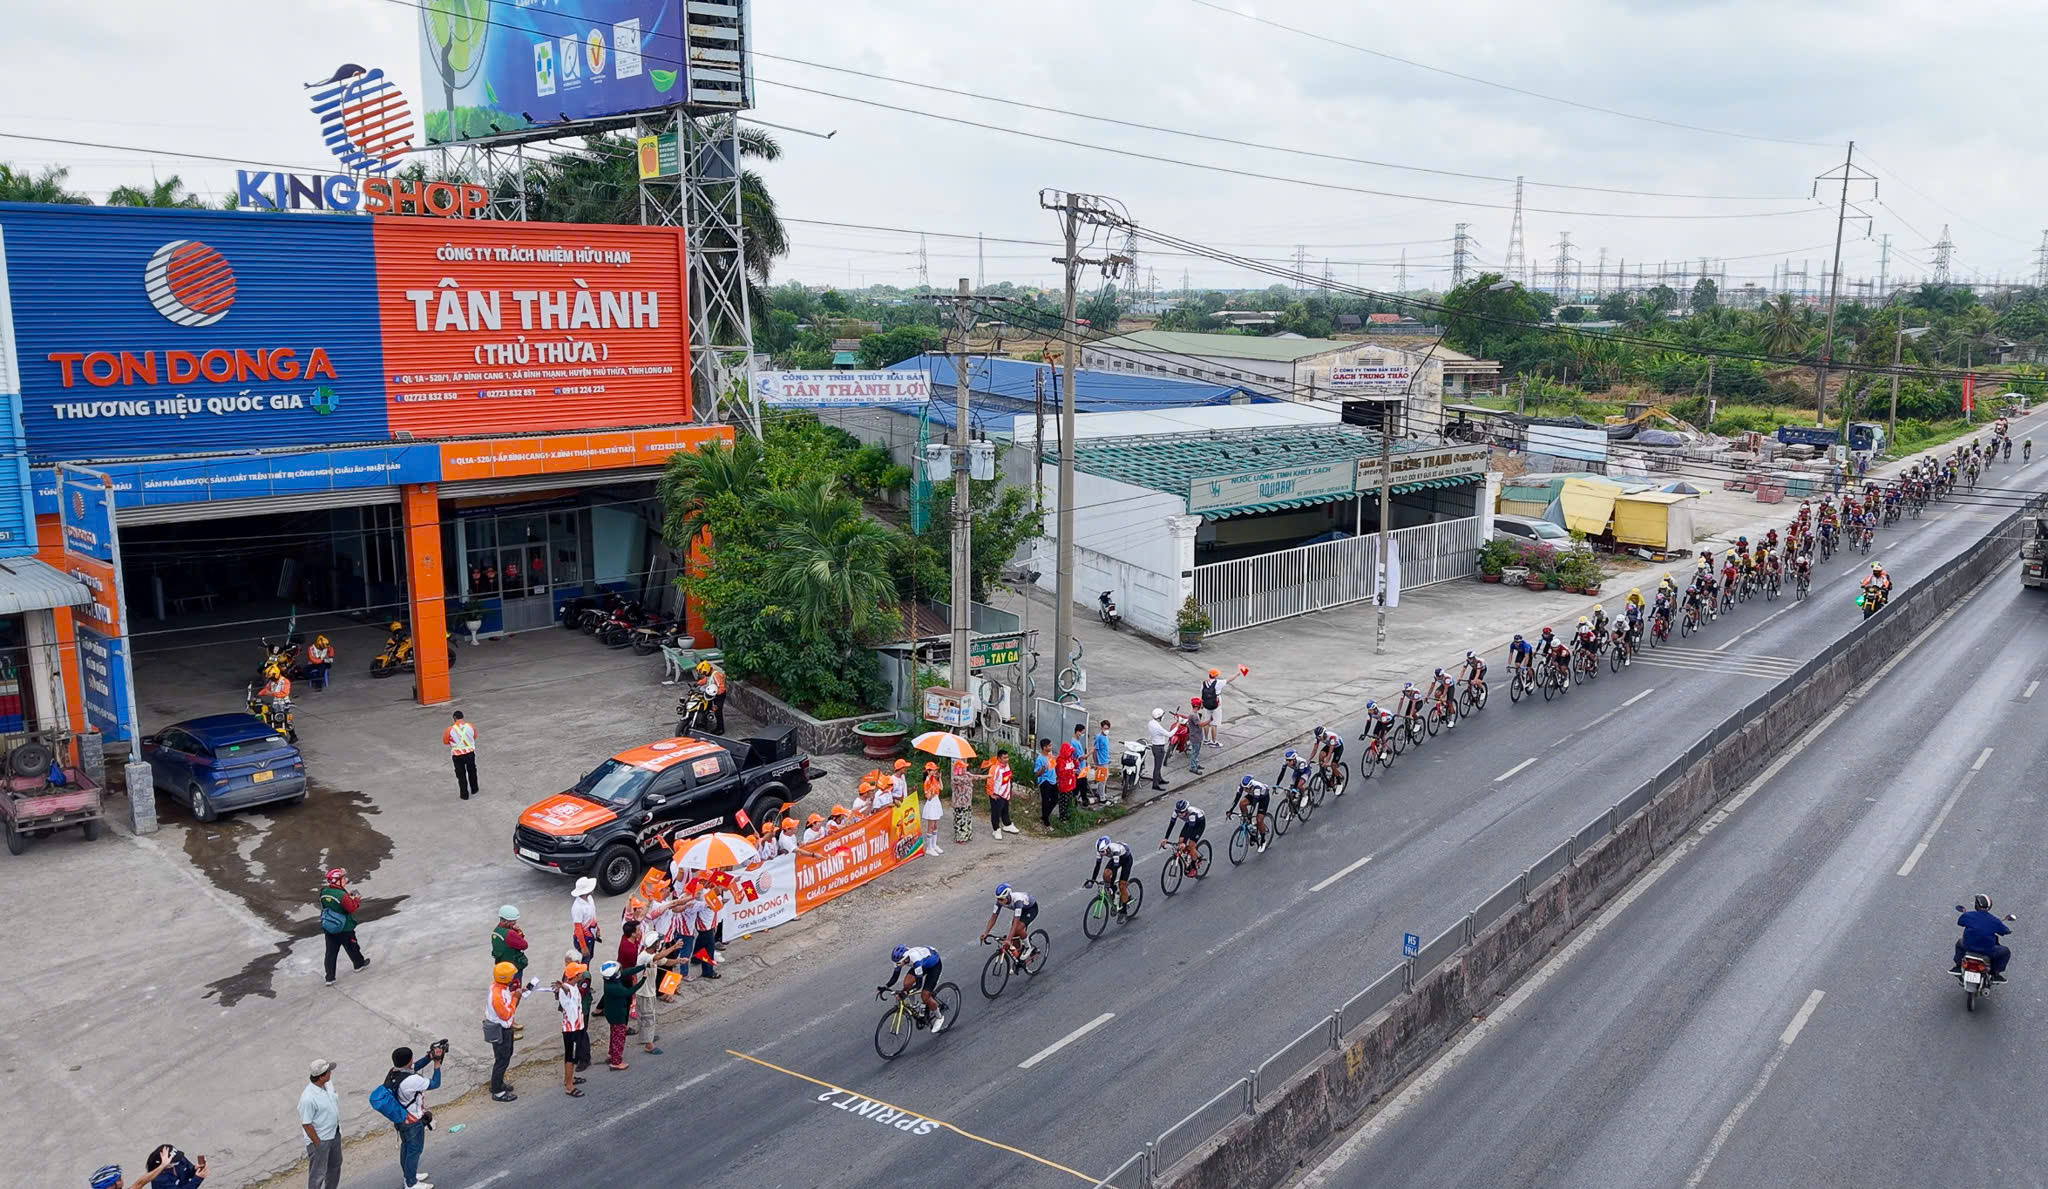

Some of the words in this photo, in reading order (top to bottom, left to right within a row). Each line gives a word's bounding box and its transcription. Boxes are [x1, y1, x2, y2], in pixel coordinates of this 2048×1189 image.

[436, 242, 474, 262] CÔNG
[476, 247, 492, 262] TY
[493, 244, 535, 262] TRÁCH
[537, 246, 574, 267] NHIỆM
[575, 246, 603, 264] HỮU
[604, 249, 631, 268] HẠN
[406, 276, 501, 332] TÂN
[513, 278, 660, 331] THÀNH
[48, 352, 157, 388] TON
[166, 348, 299, 385] DONG
[303, 347, 338, 381] A
[402, 375, 413, 384] QL
[464, 372, 482, 382] BÌNH
[484, 372, 504, 381] CANG
[512, 370, 522, 379] XÃ
[524, 370, 541, 379] BÌNH
[569, 367, 592, 378] HUYỆN
[593, 366, 606, 376] THỦ
[645, 366, 661, 375] LONG
[663, 366, 673, 374] AN
[782, 373, 809, 381] CÔNG
[403, 393, 427, 402] 02723
[428, 393, 442, 401] 832
[486, 390, 508, 398] 02723
[783, 381, 820, 396] TÂN
[825, 381, 890, 397] THÀNH
[895, 382, 926, 399] LỢI
[53, 400, 151, 420] THƯƠNG
[155, 393, 202, 419] HIỆU
[207, 389, 264, 416] QUỐC
[269, 394, 304, 411] GIA
[1423, 453, 1453, 468] THẠNH
[144, 479, 163, 489] SẢN
[227, 472, 247, 483] XUẤT
[295, 468, 315, 478] CÔNG
[1276, 471, 1293, 480] TINH
[991, 652, 1006, 664] TAY
[1007, 650, 1019, 662] GA
[796, 863, 815, 890] TÂN
[815, 853, 845, 882] THÀNH
[851, 836, 868, 865] THỦ
[869, 830, 890, 857] THỪA
[806, 884, 827, 900] CHÀO
[732, 906, 755, 921] TON
[757, 894, 782, 915] DONG
[783, 892, 790, 902] A
[817, 1087, 844, 1102] 2
[832, 1094, 941, 1136] SPRINT
